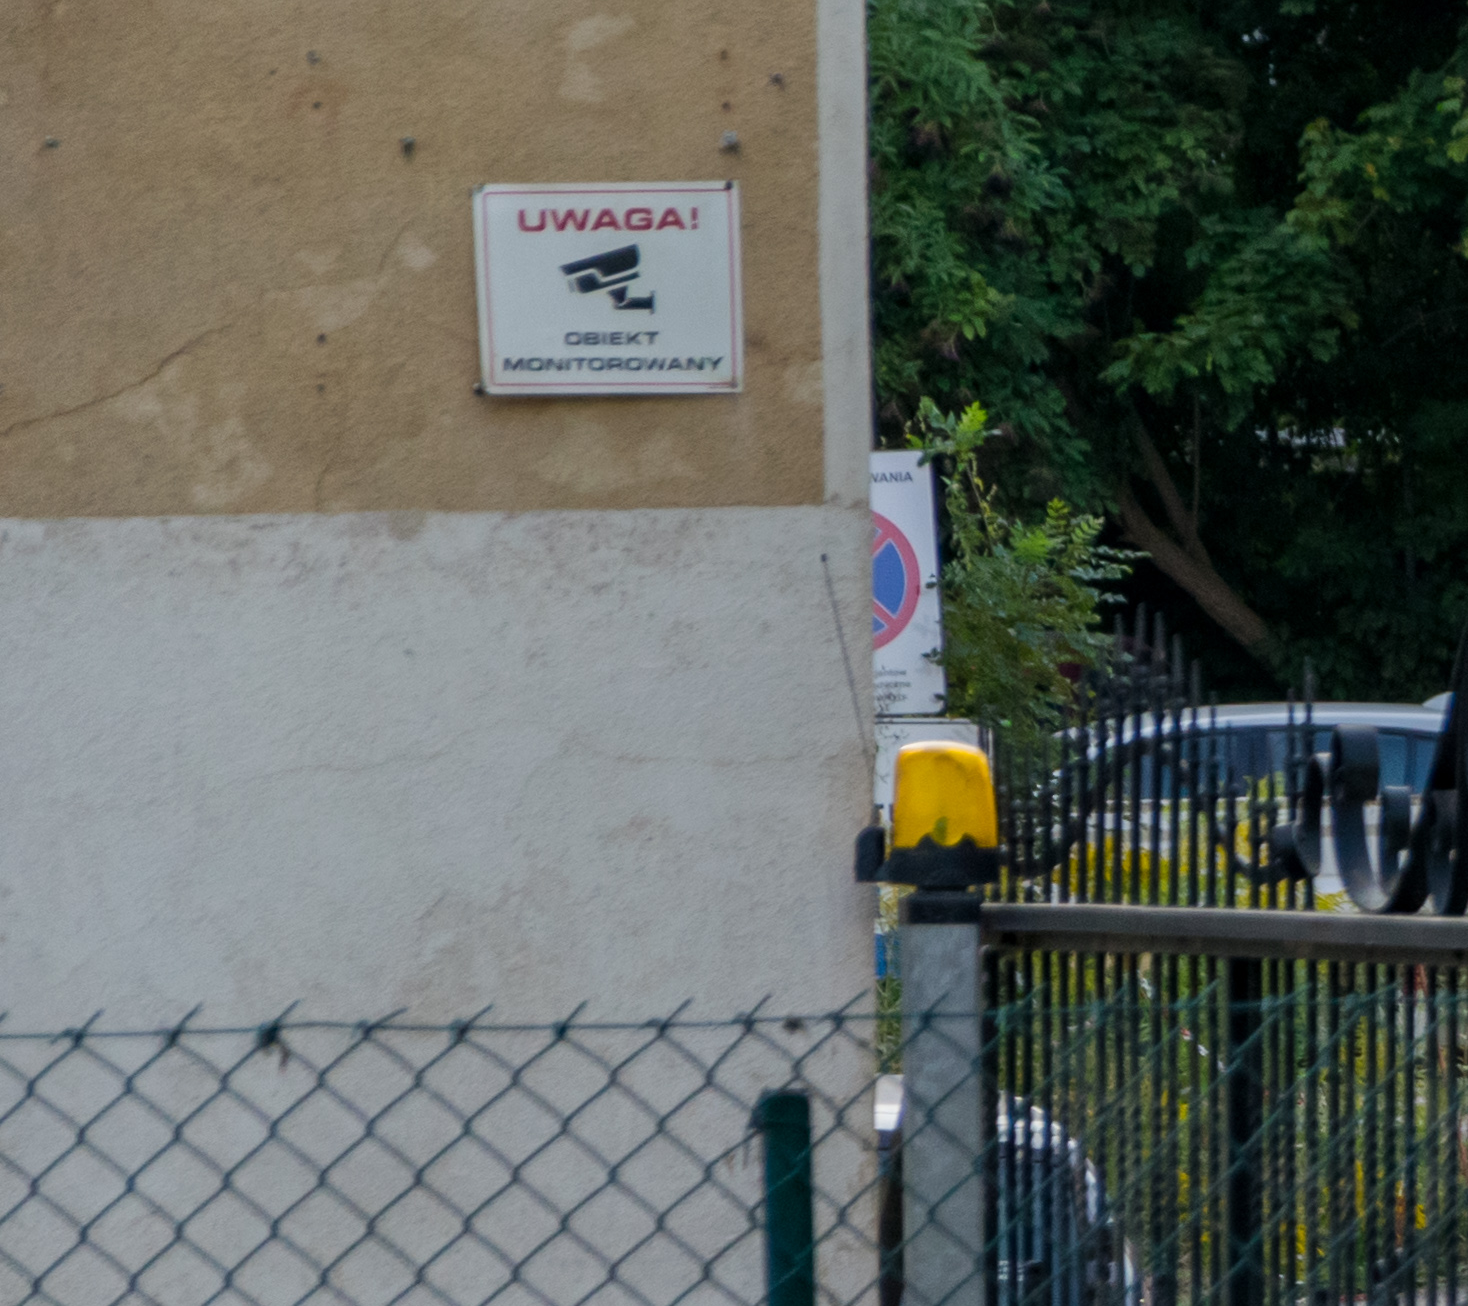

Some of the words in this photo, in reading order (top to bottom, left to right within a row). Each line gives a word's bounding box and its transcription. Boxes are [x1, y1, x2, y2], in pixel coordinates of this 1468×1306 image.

[517, 207, 699, 232] UWAGA!
[564, 331, 659, 345] OBIEKT
[502, 356, 725, 372] MONITOROWANY
